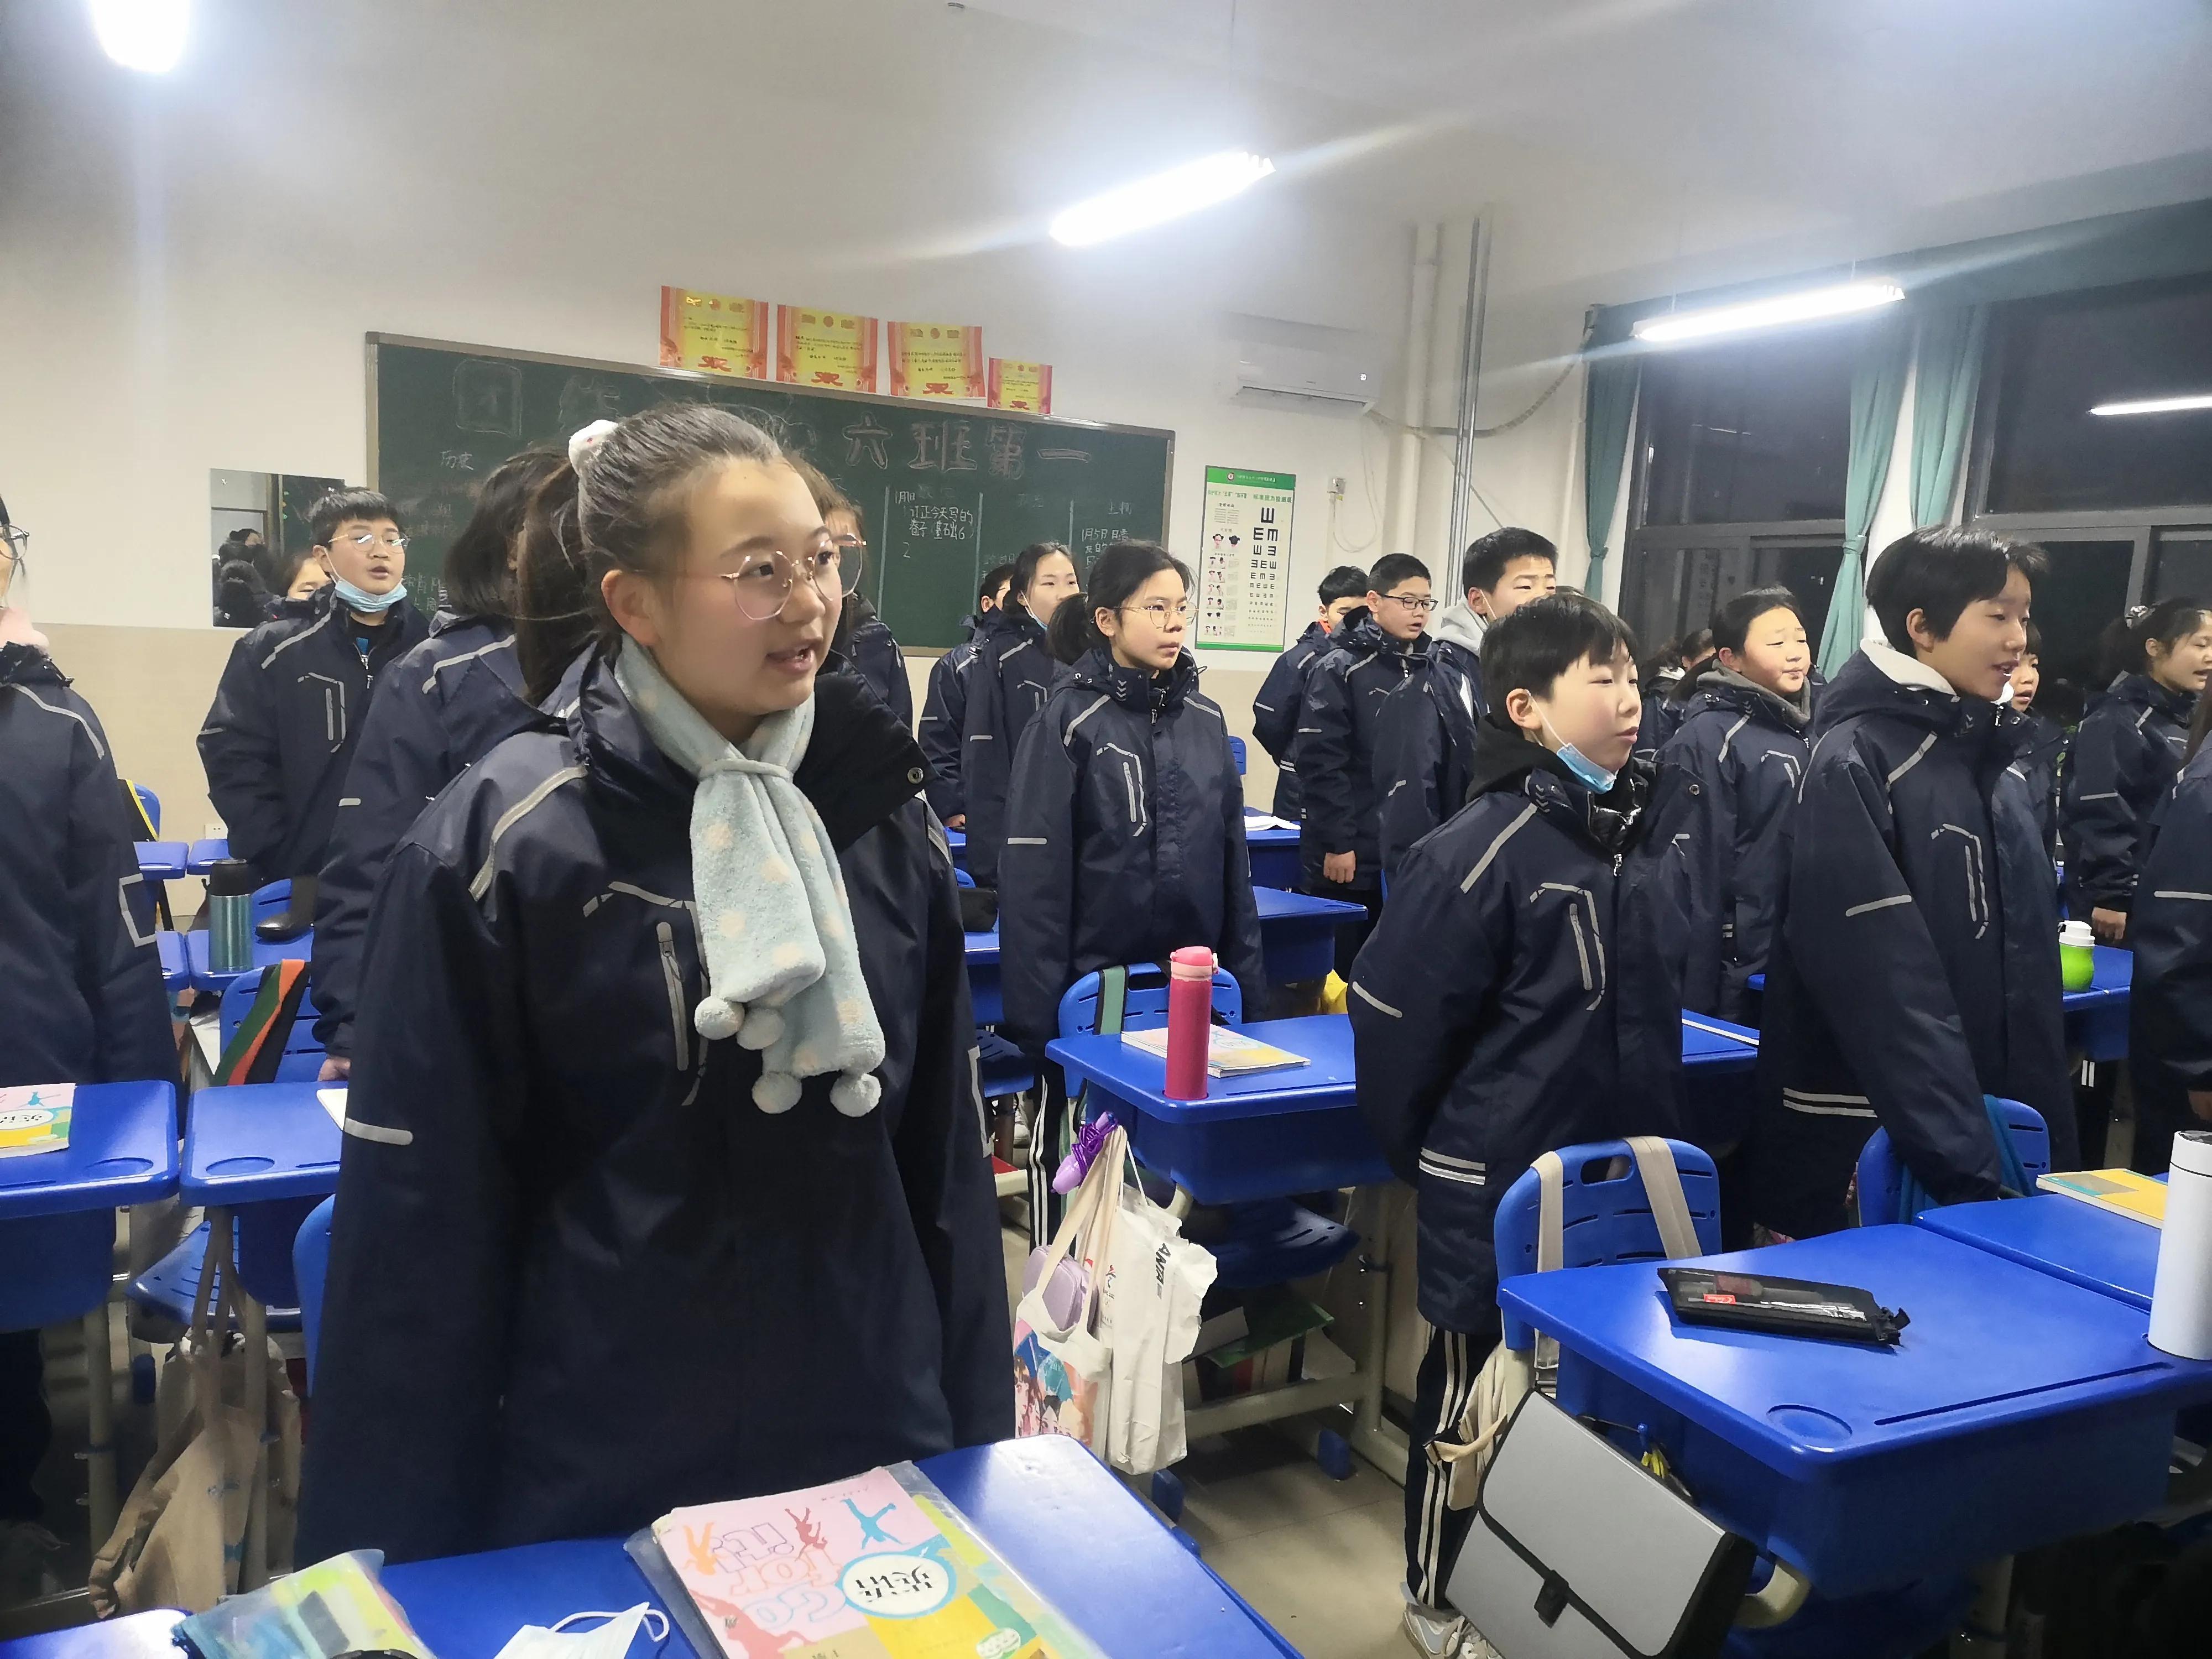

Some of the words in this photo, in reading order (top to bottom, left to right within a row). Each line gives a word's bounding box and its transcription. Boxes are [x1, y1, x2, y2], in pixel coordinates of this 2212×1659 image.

[910, 505, 973, 526] 订正今天写的
[1155, 1243, 1171, 1285] ANTA
[711, 1522, 794, 1573] it!
[730, 1547, 842, 1596] for
[855, 1566, 933, 1603] 英语
